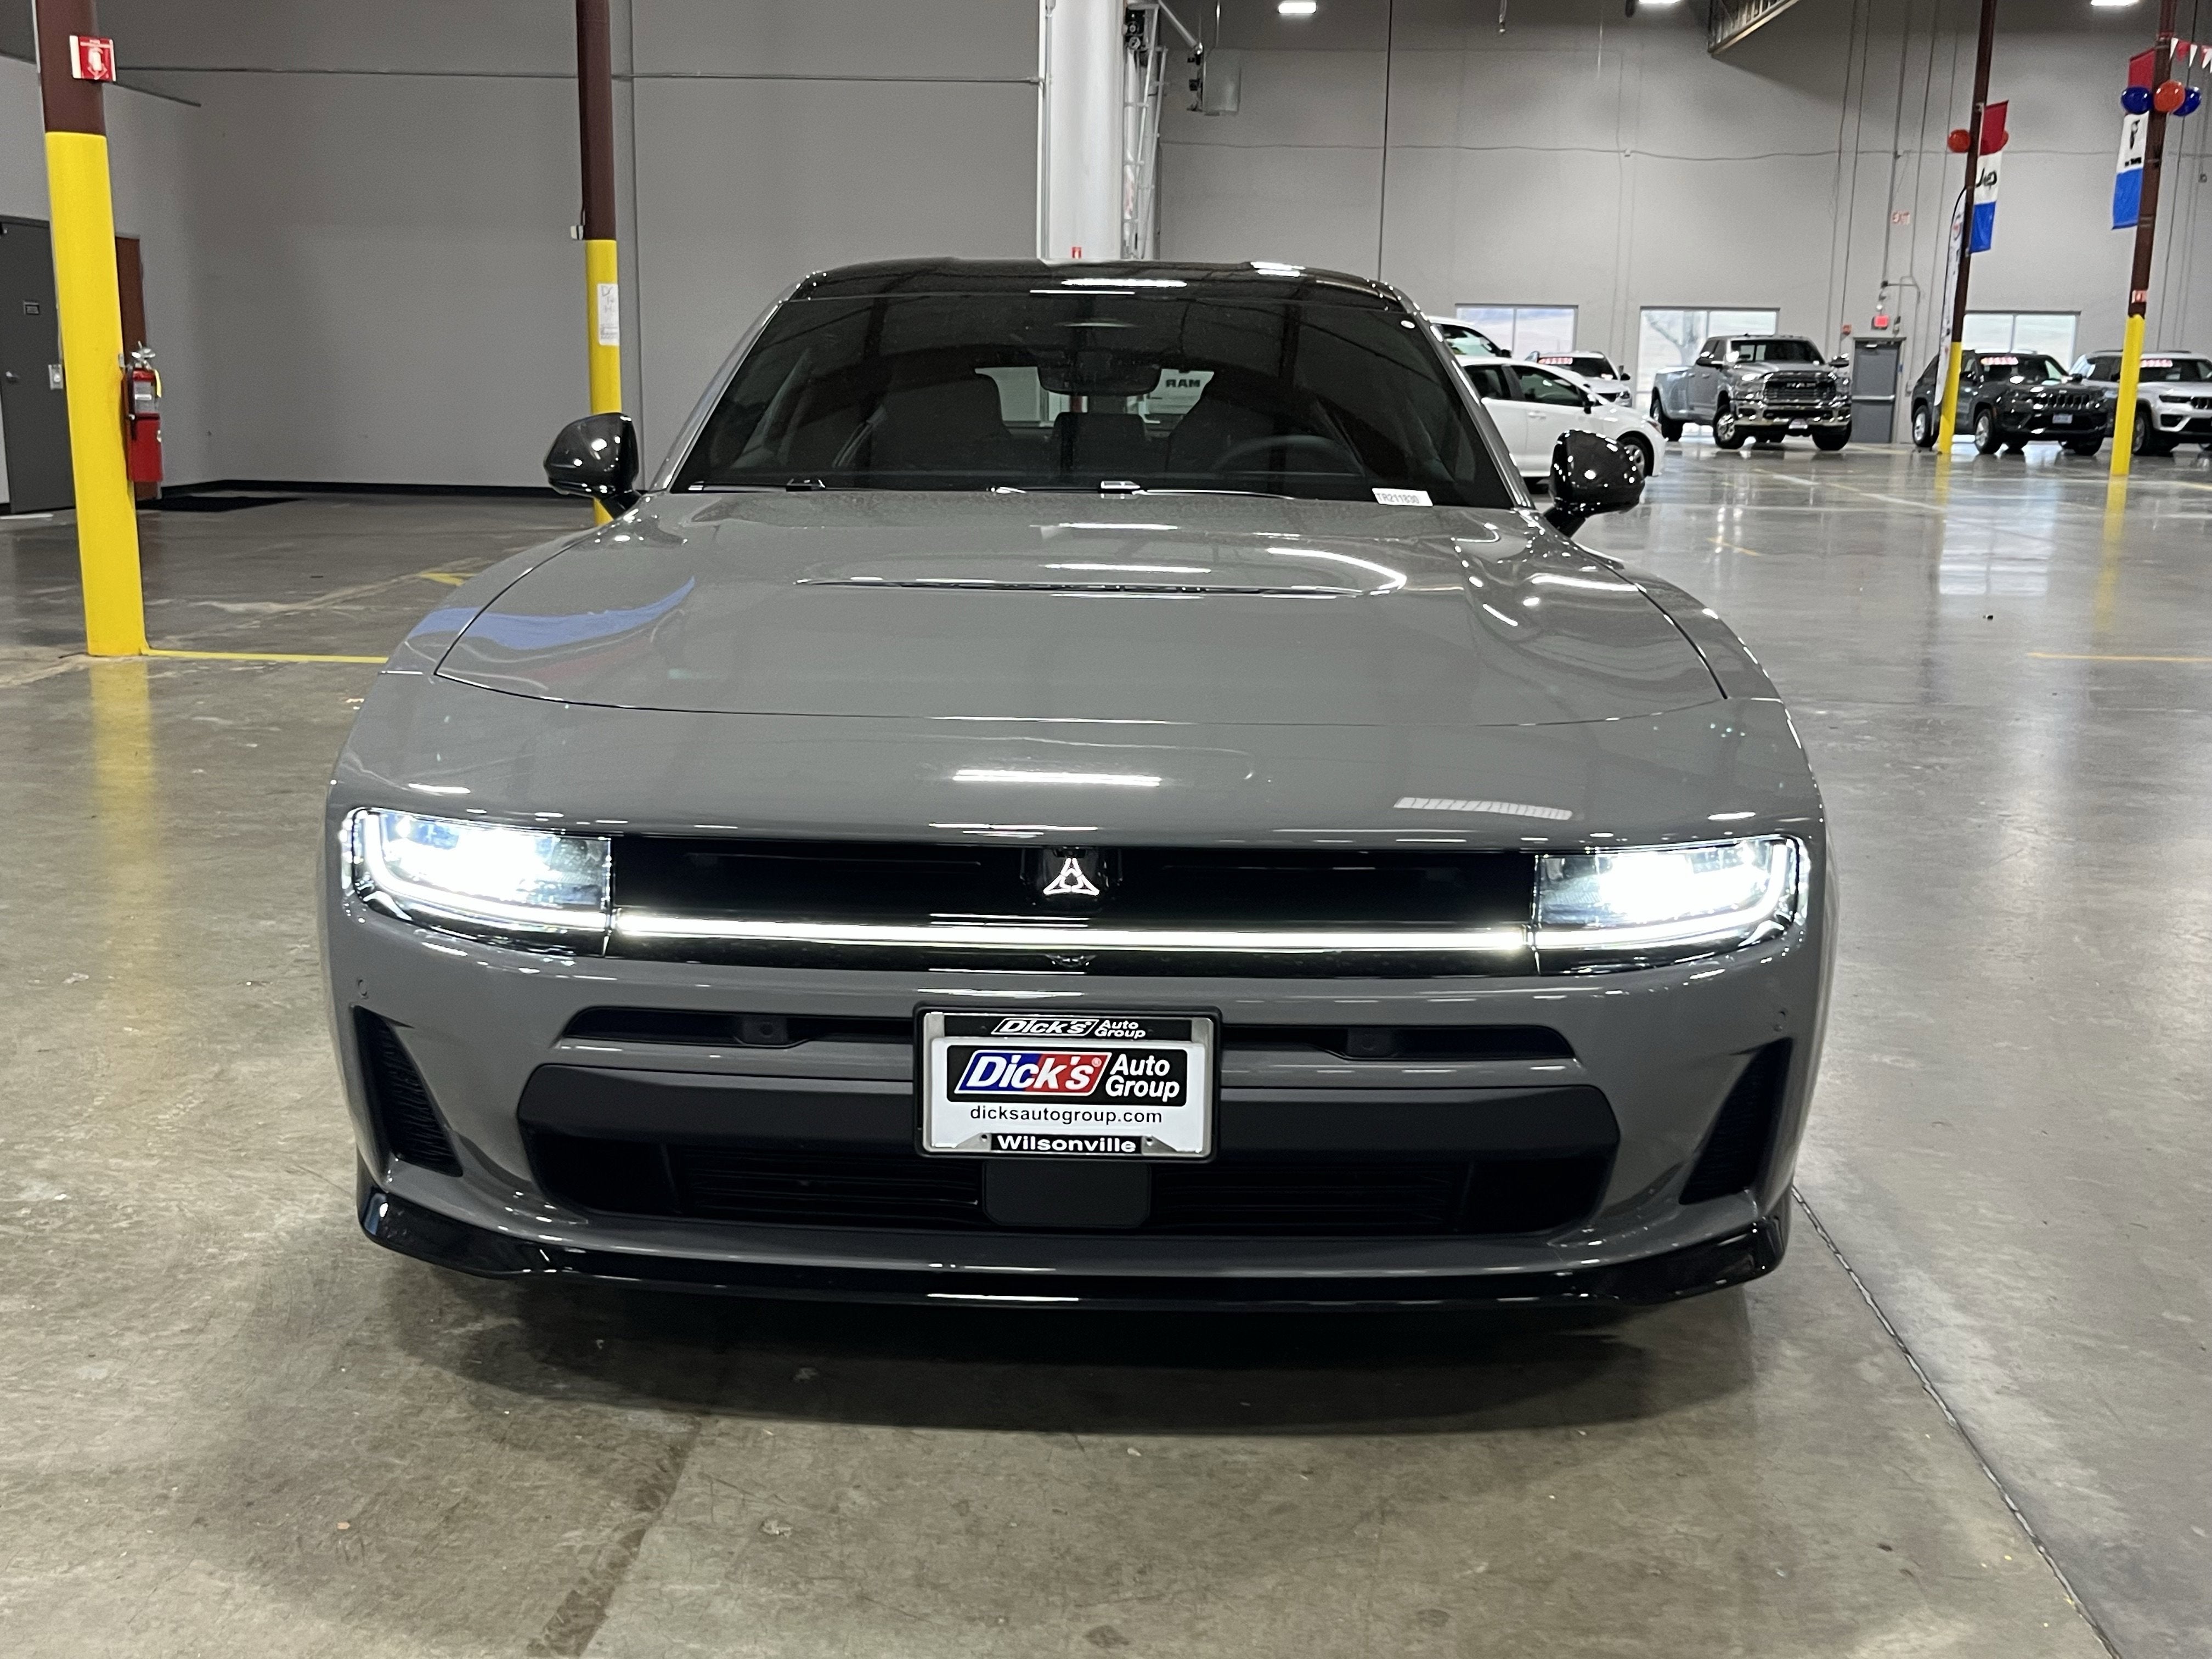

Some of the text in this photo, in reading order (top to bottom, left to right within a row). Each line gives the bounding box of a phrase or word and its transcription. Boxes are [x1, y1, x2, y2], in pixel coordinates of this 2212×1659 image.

[1165, 379, 1201, 388] RAM
[998, 1019, 1087, 1035] Dick's
[1094, 1028, 1146, 1039] Group
[1101, 1019, 1139, 1030] Auto
[966, 1054, 1094, 1090] Dick's
[1109, 1053, 1170, 1076] Auto
[1105, 1075, 1180, 1102] Group
[970, 1105, 1163, 1125] dicksautogroup.com
[997, 1135, 1137, 1153] Wilsonville
